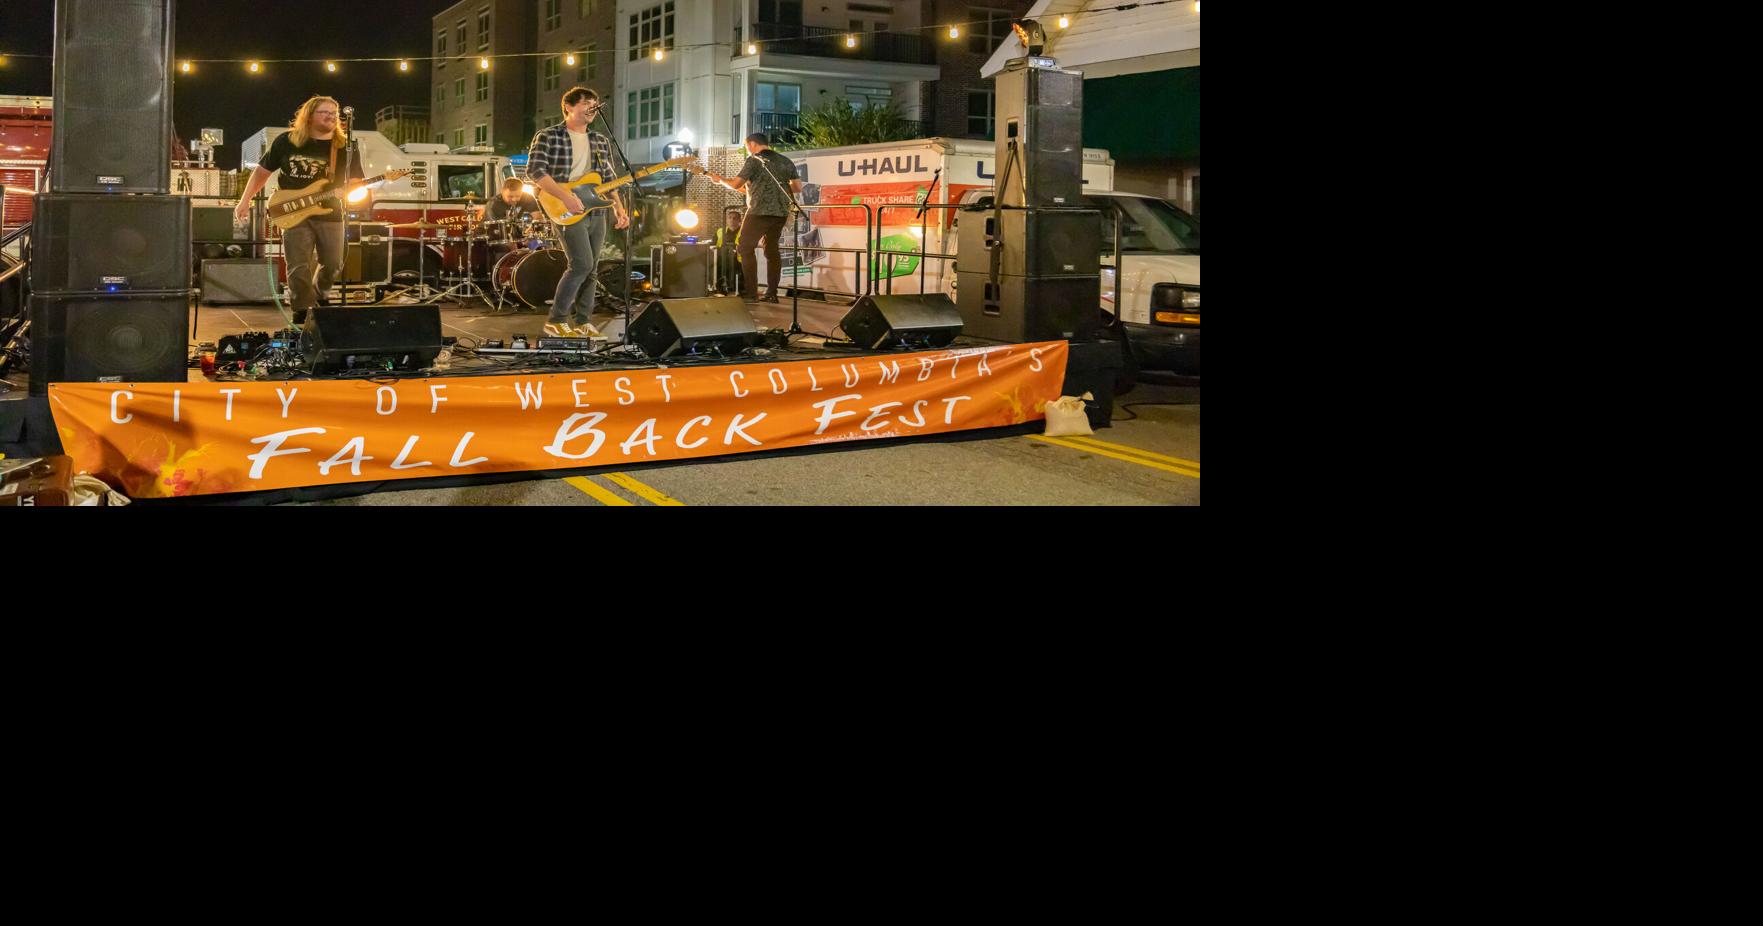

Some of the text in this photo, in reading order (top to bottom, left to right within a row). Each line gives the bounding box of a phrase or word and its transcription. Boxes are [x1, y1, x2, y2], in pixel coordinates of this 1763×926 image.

[838, 155, 928, 176] U-HAUL
[888, 196, 914, 204] SHARE
[436, 216, 460, 225] WEST
[110, 387, 298, 424] CITY
[376, 385, 448, 416] OF
[515, 375, 672, 410] WEST
